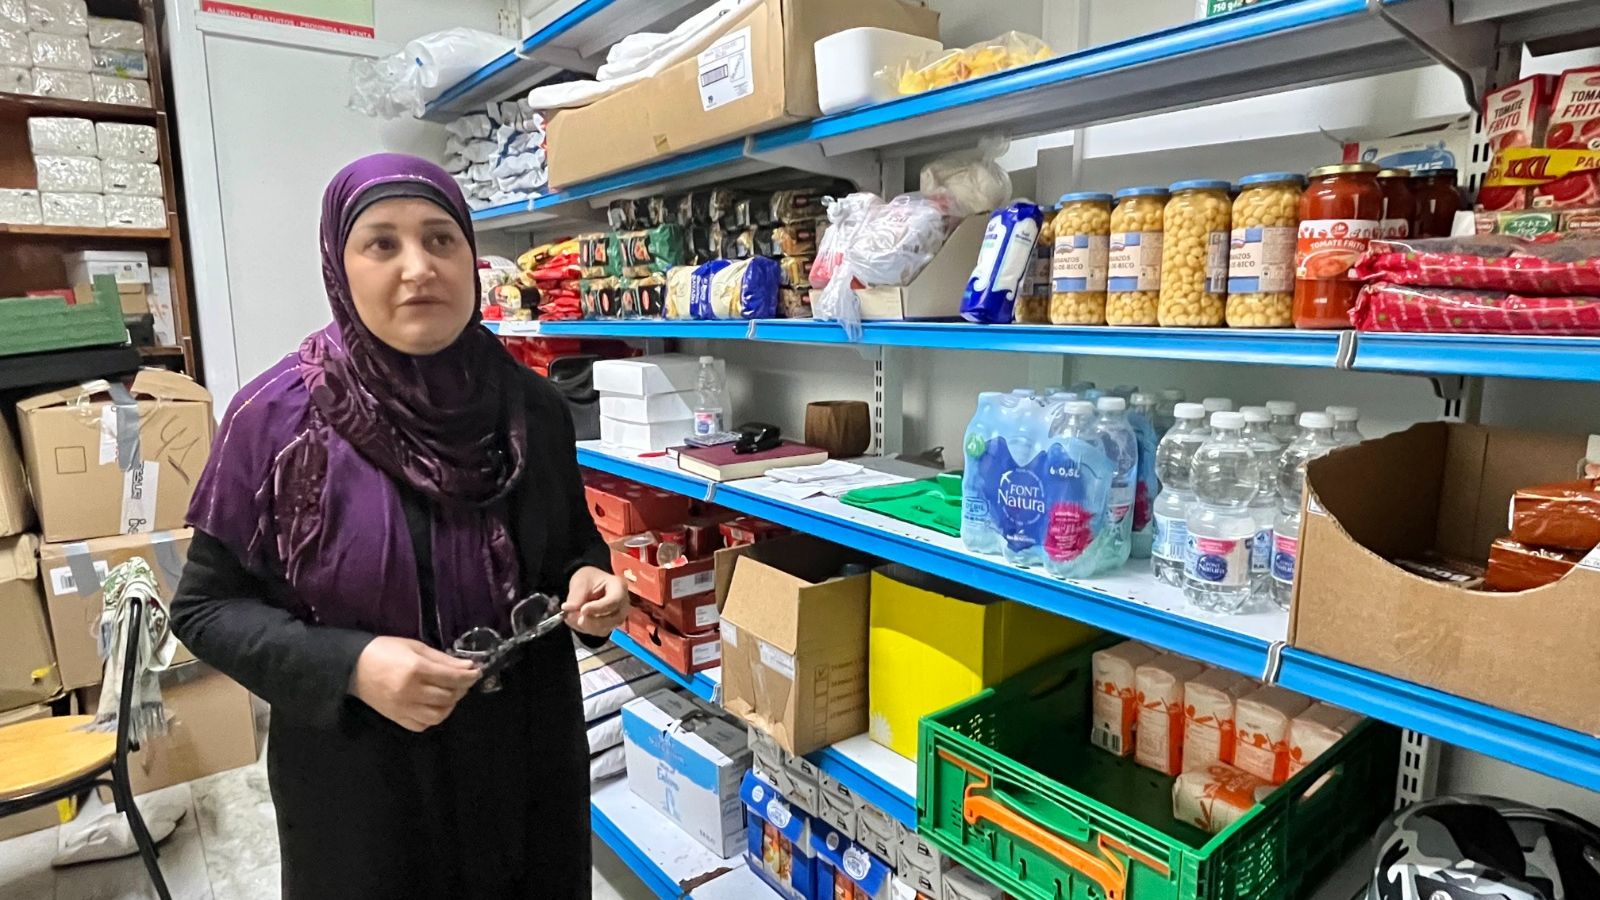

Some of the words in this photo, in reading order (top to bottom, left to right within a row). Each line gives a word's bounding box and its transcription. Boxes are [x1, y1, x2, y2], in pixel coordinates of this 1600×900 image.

[207, 6, 250, 19] ALIMENTOS
[252, 14, 294, 26] GRATUITOS
[1213, 2, 1226, 14] 750
[1494, 99, 1524, 119] TOMATE
[1561, 102, 1600, 118] FRIT
[1488, 111, 1521, 133] FRITO
[1504, 155, 1558, 179] XXL
[1310, 239, 1341, 249] TOMATE
[1343, 239, 1366, 251] FRITO
[1009, 483, 1040, 498] FONT
[997, 488, 1046, 514] Natura
[1198, 564, 1226, 574] Natura
